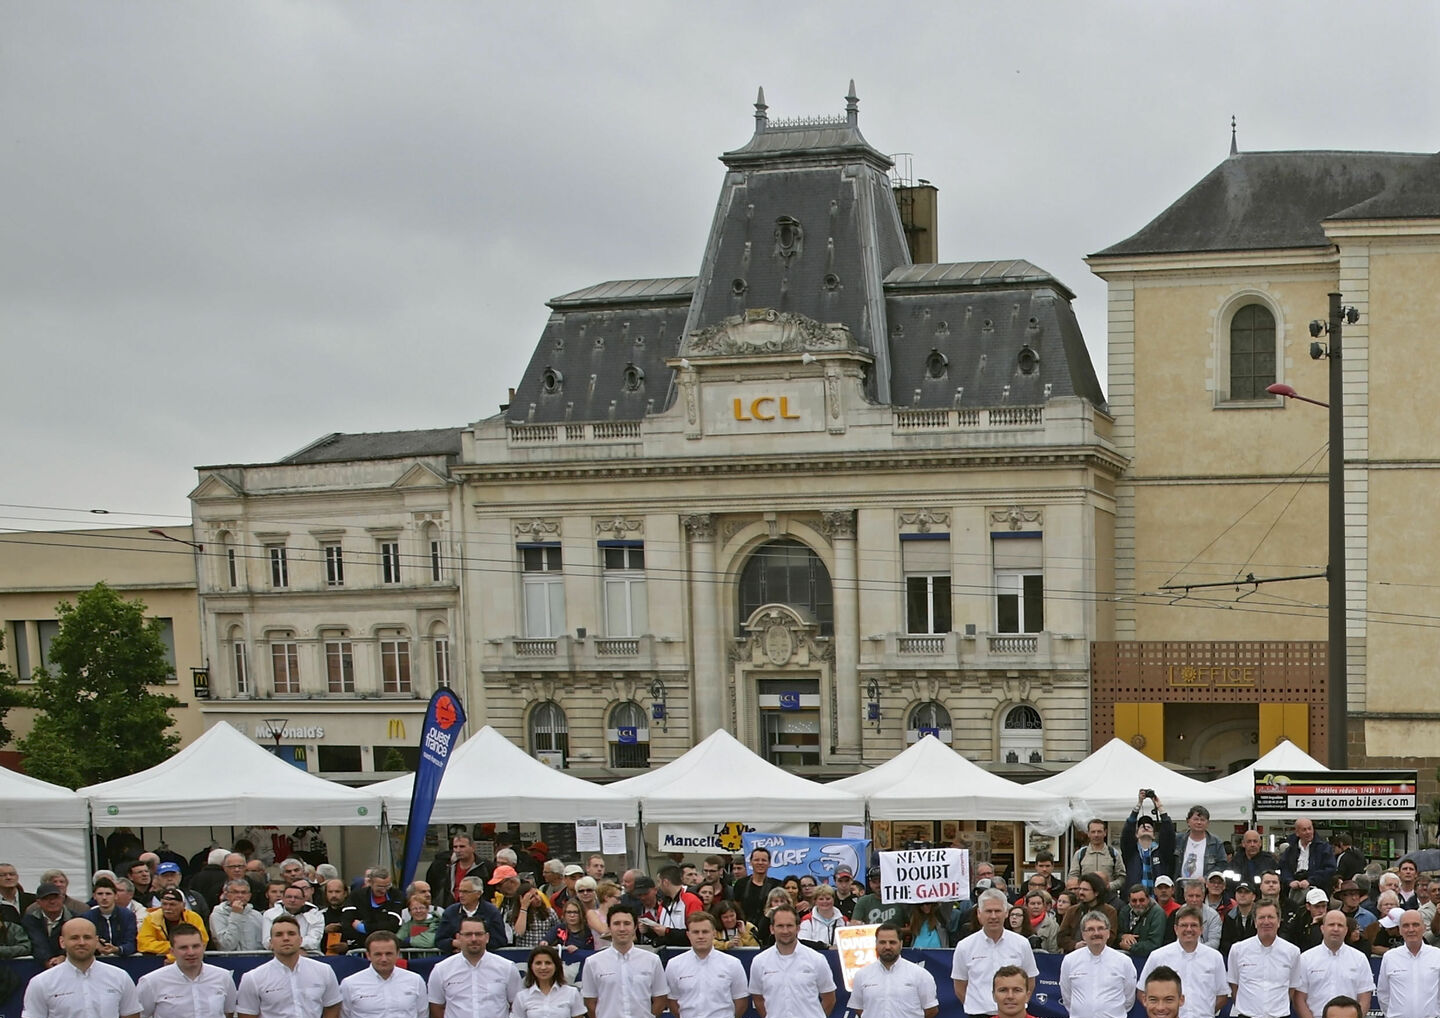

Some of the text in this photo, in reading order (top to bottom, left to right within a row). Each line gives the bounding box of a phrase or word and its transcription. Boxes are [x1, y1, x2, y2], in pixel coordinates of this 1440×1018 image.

[733, 396, 801, 421] LCL
[1295, 796, 1409, 807] rs-automobiles.com
[664, 835, 722, 848] Mancelle
[750, 837, 785, 849] TEAM
[897, 850, 947, 864] NEVER
[897, 864, 950, 882] DOUBT
[884, 882, 959, 900] THE GADE
